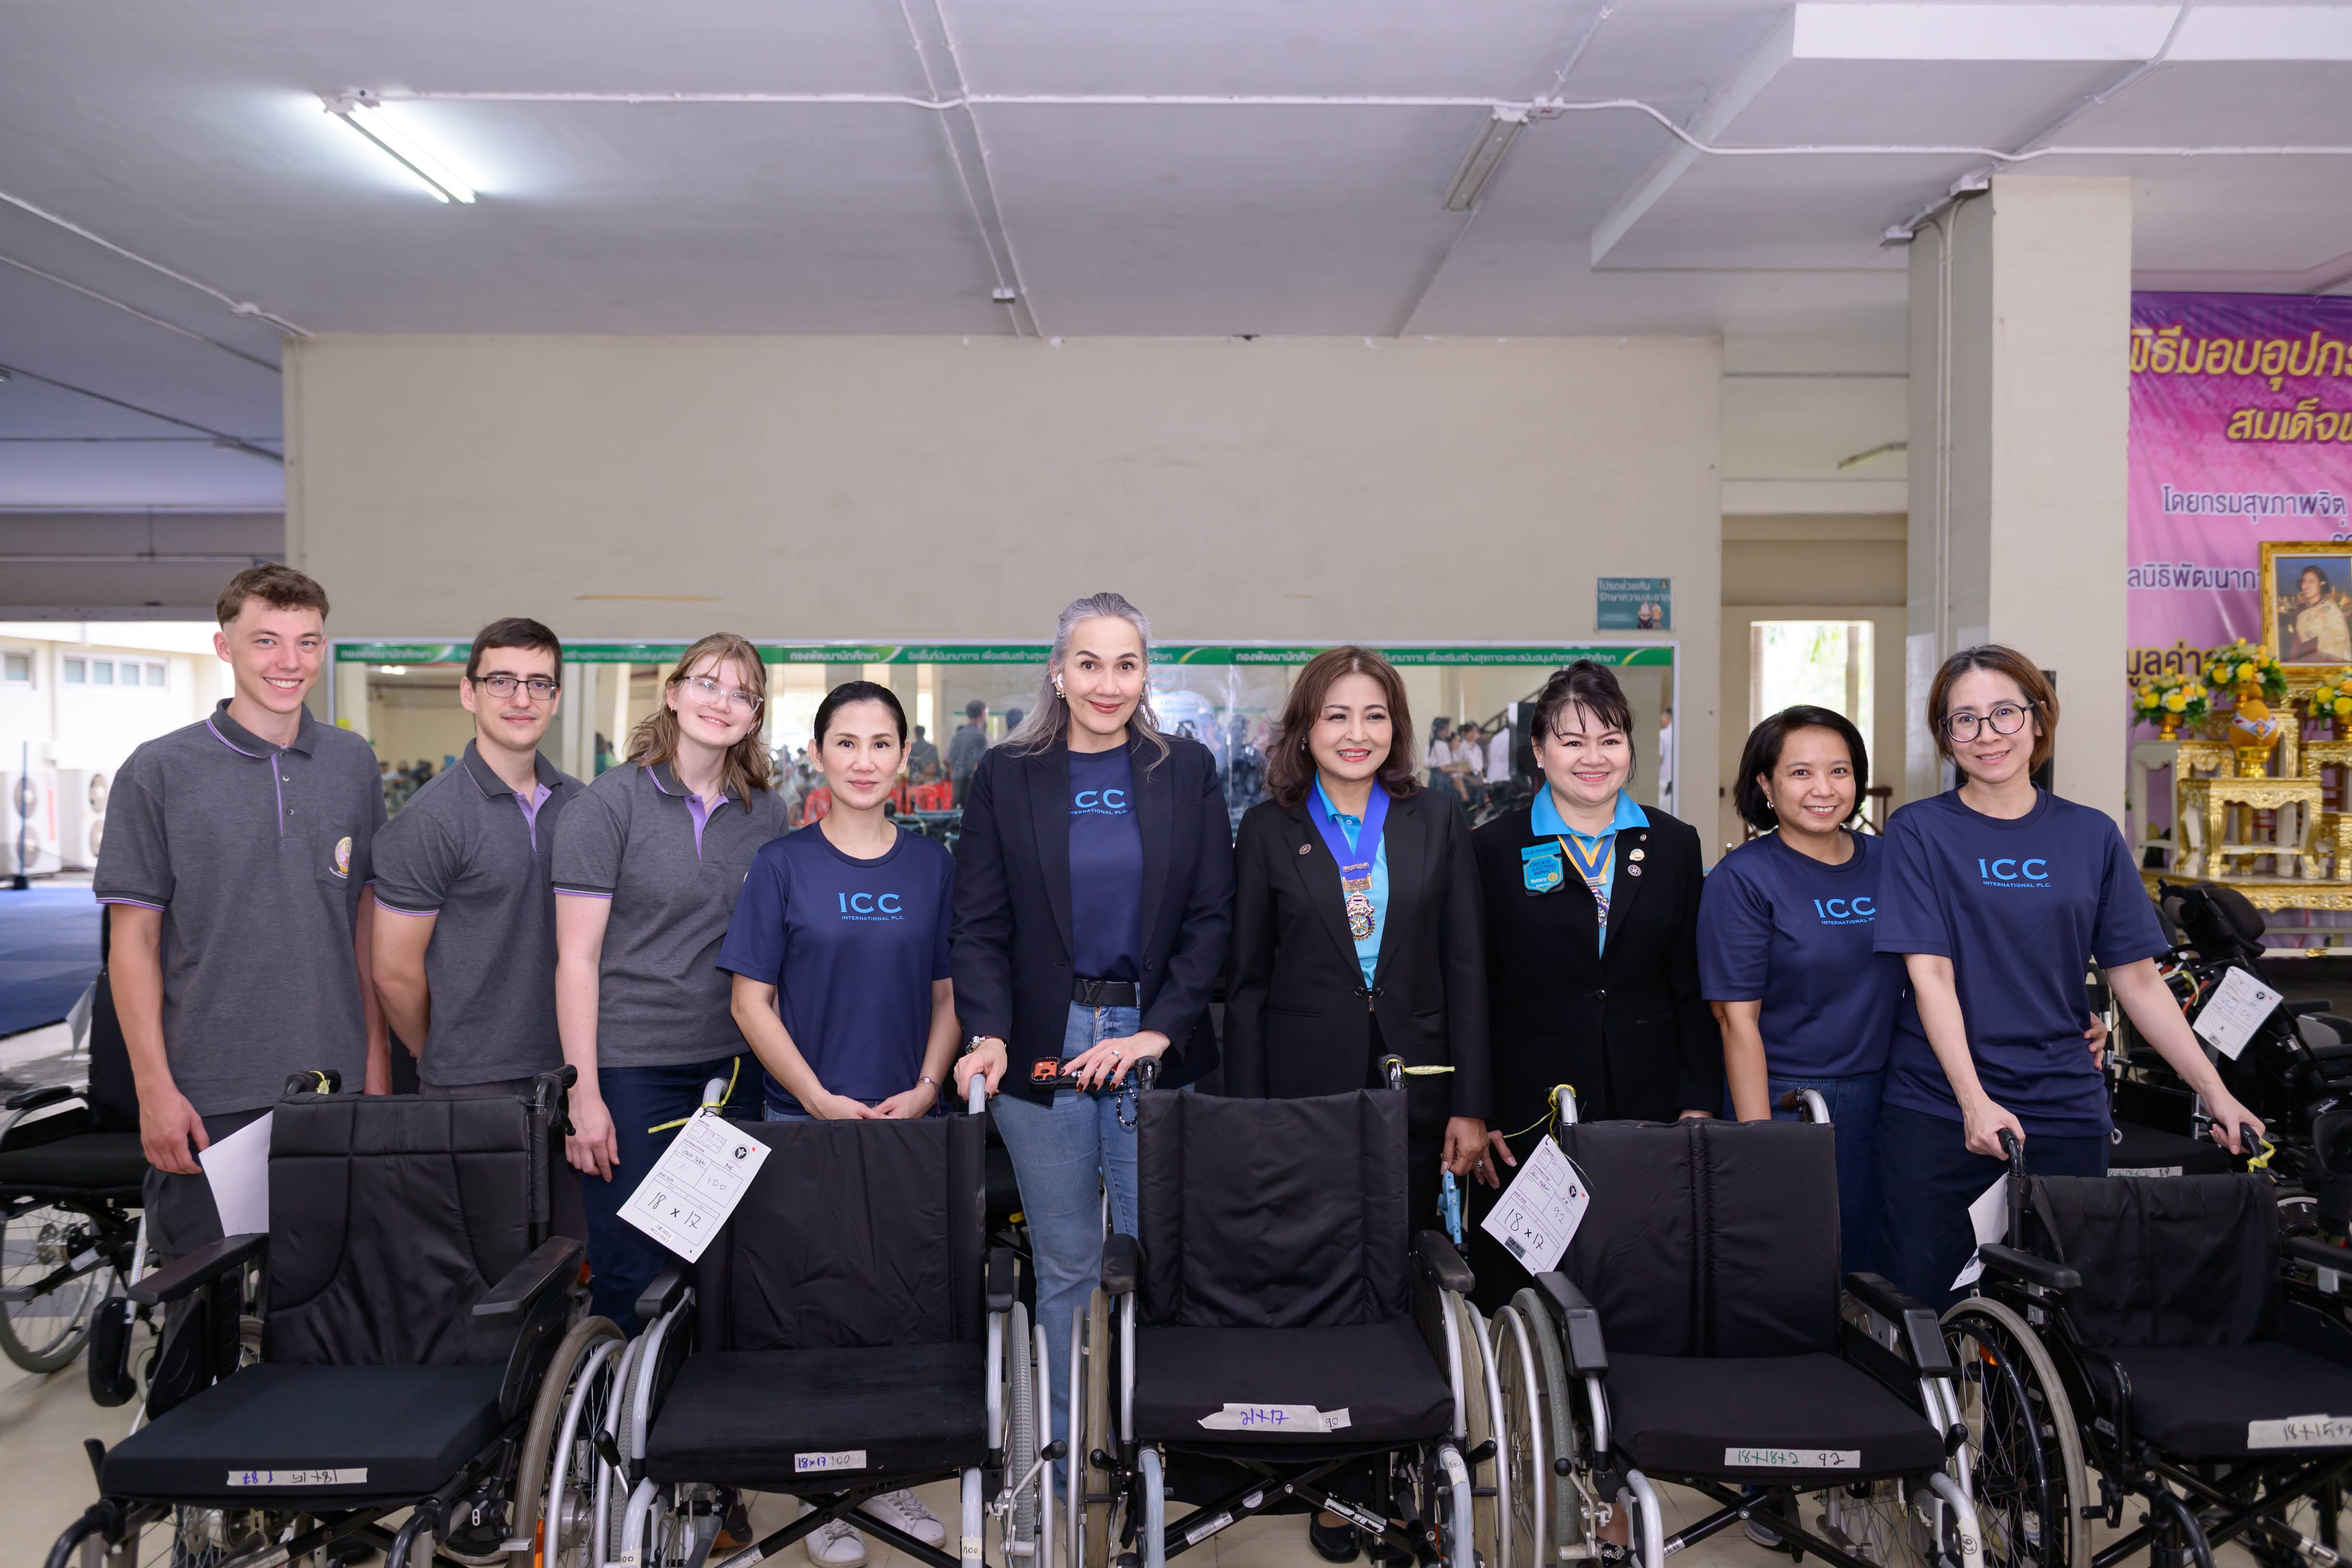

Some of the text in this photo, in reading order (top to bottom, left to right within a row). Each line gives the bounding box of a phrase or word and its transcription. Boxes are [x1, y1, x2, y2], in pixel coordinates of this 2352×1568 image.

[2130, 325, 2352, 392] พิธีมอบอุปก
[2128, 564, 2260, 589] ลนิธิพัฒนาก
[1070, 789, 1126, 810] CC
[1529, 859, 1552, 868] CREATE
[1532, 864, 1556, 872] LASTING
[1978, 858, 2049, 880] ICC
[1533, 868, 1555, 876] IMPACT
[838, 893, 903, 914] ICC
[1813, 897, 1876, 918] ICC
[698, 1119, 711, 1128] ARRIVAL
[683, 1138, 705, 1153] DISTRIBUTION
[1544, 1146, 1555, 1159] ARRIVAL
[694, 1155, 706, 1167] THANI
[1532, 1163, 1550, 1182] DISTRIBUTION
[708, 1177, 726, 1190] 100
[648, 1192, 666, 1209] 18
[1505, 1208, 1523, 1231] 18
[1554, 1207, 1565, 1224] 92
[1325, 1417, 1339, 1428] 90
[832, 1454, 850, 1466] 100
[1819, 1452, 1845, 1466] 92
[963, 1545, 978, 1554] 100
